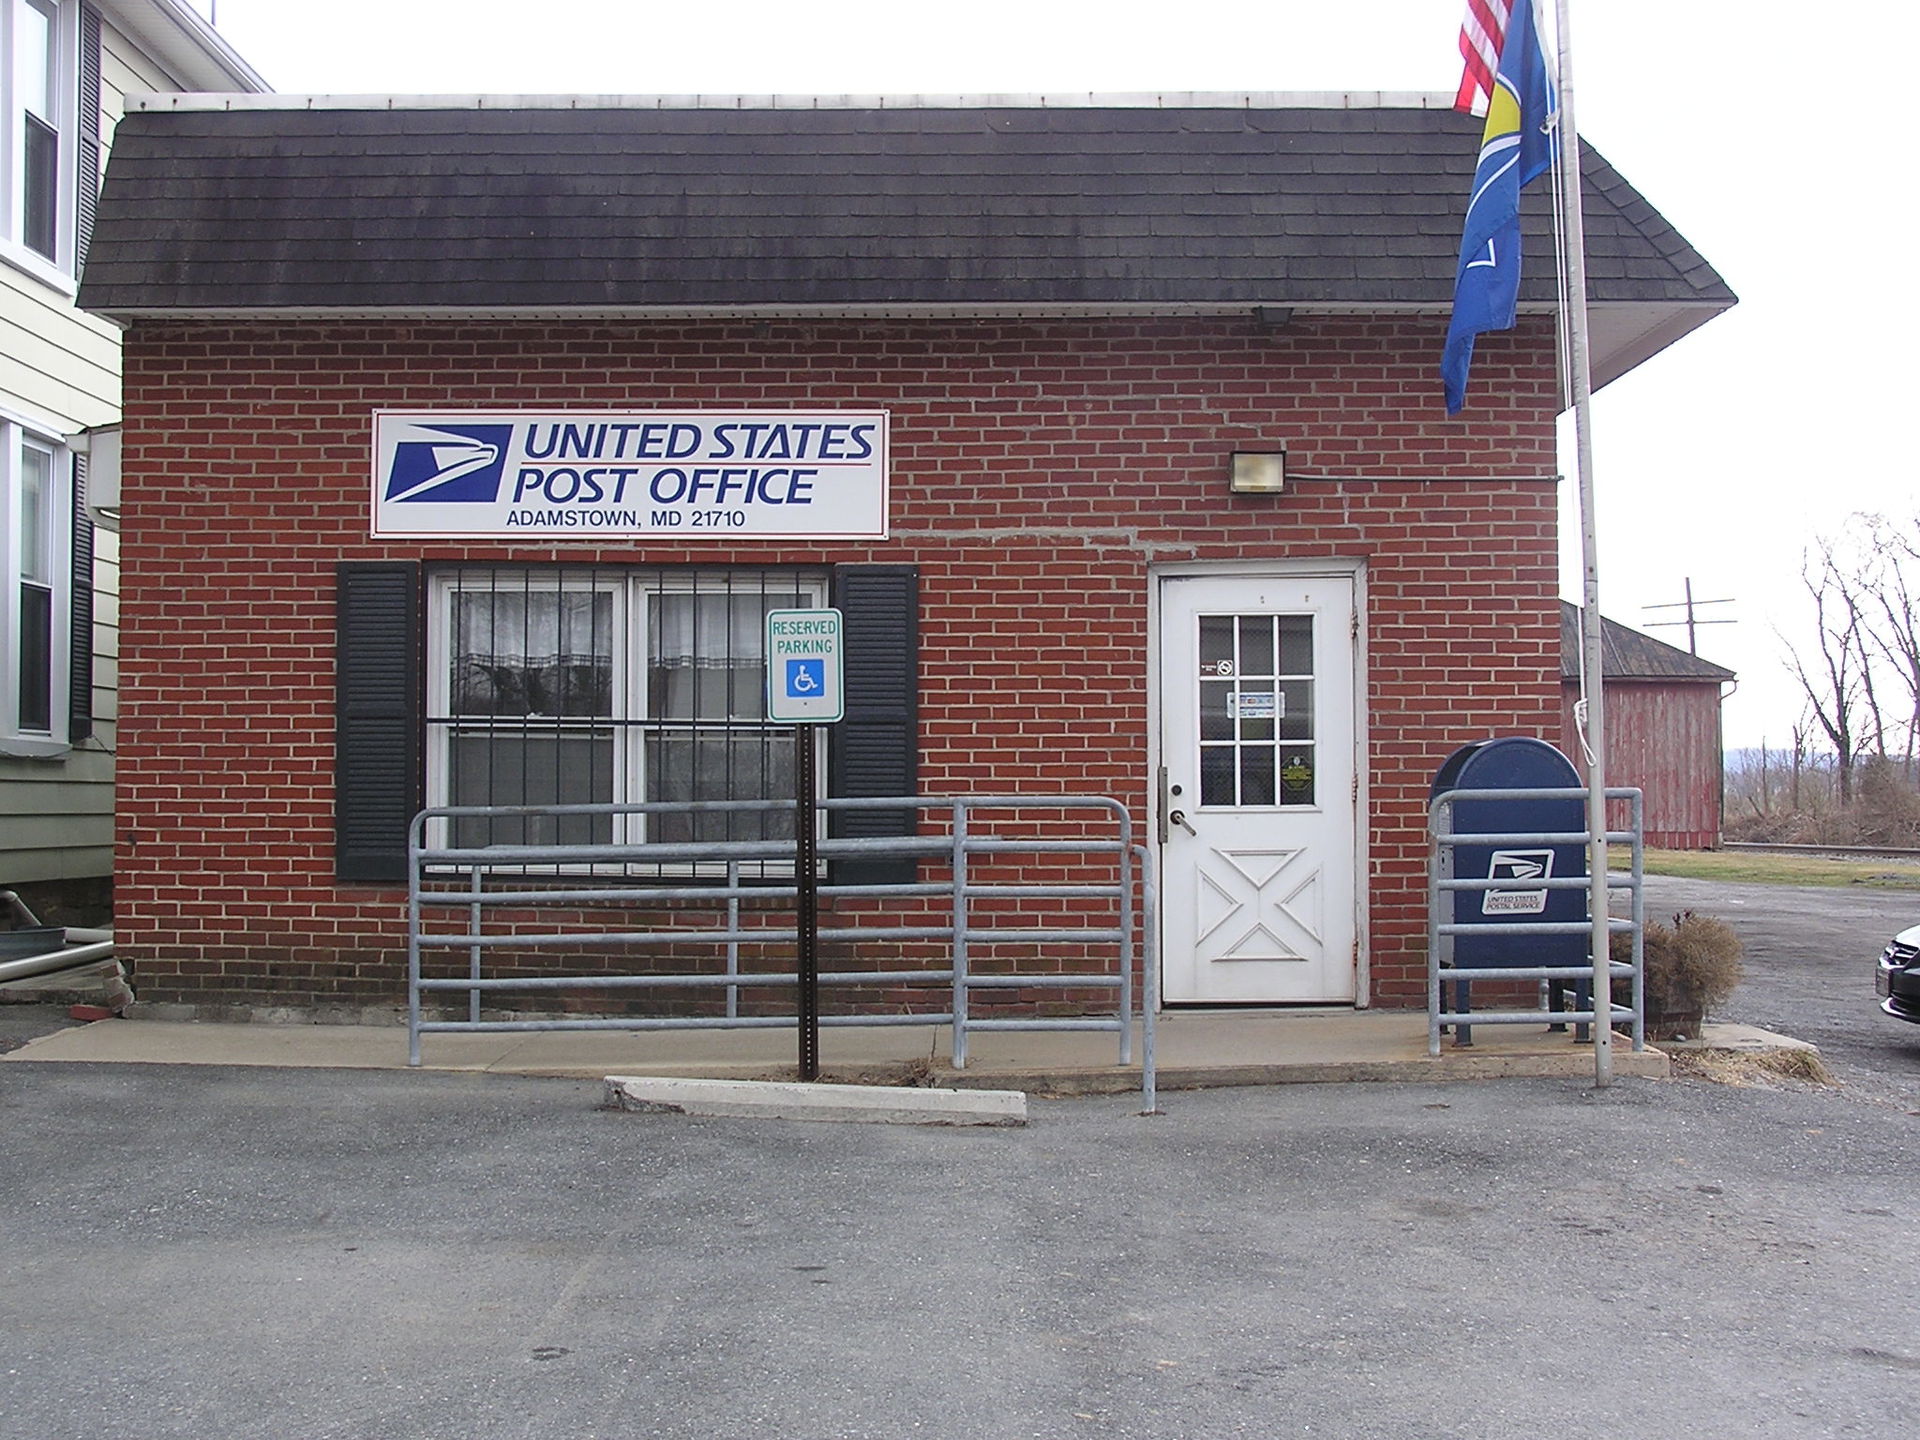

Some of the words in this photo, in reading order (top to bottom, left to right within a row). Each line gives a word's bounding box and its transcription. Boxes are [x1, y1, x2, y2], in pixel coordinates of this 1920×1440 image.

[525, 424, 701, 459] UNITED
[708, 424, 876, 459] STATES
[512, 468, 639, 504] POST
[650, 468, 818, 504] OFFICE
[506, 510, 642, 529] ADAMSTOWN,
[651, 510, 682, 527] MD
[691, 510, 746, 527] 21710
[773, 620, 836, 635] RESERVED
[777, 639, 832, 654] PARKING
